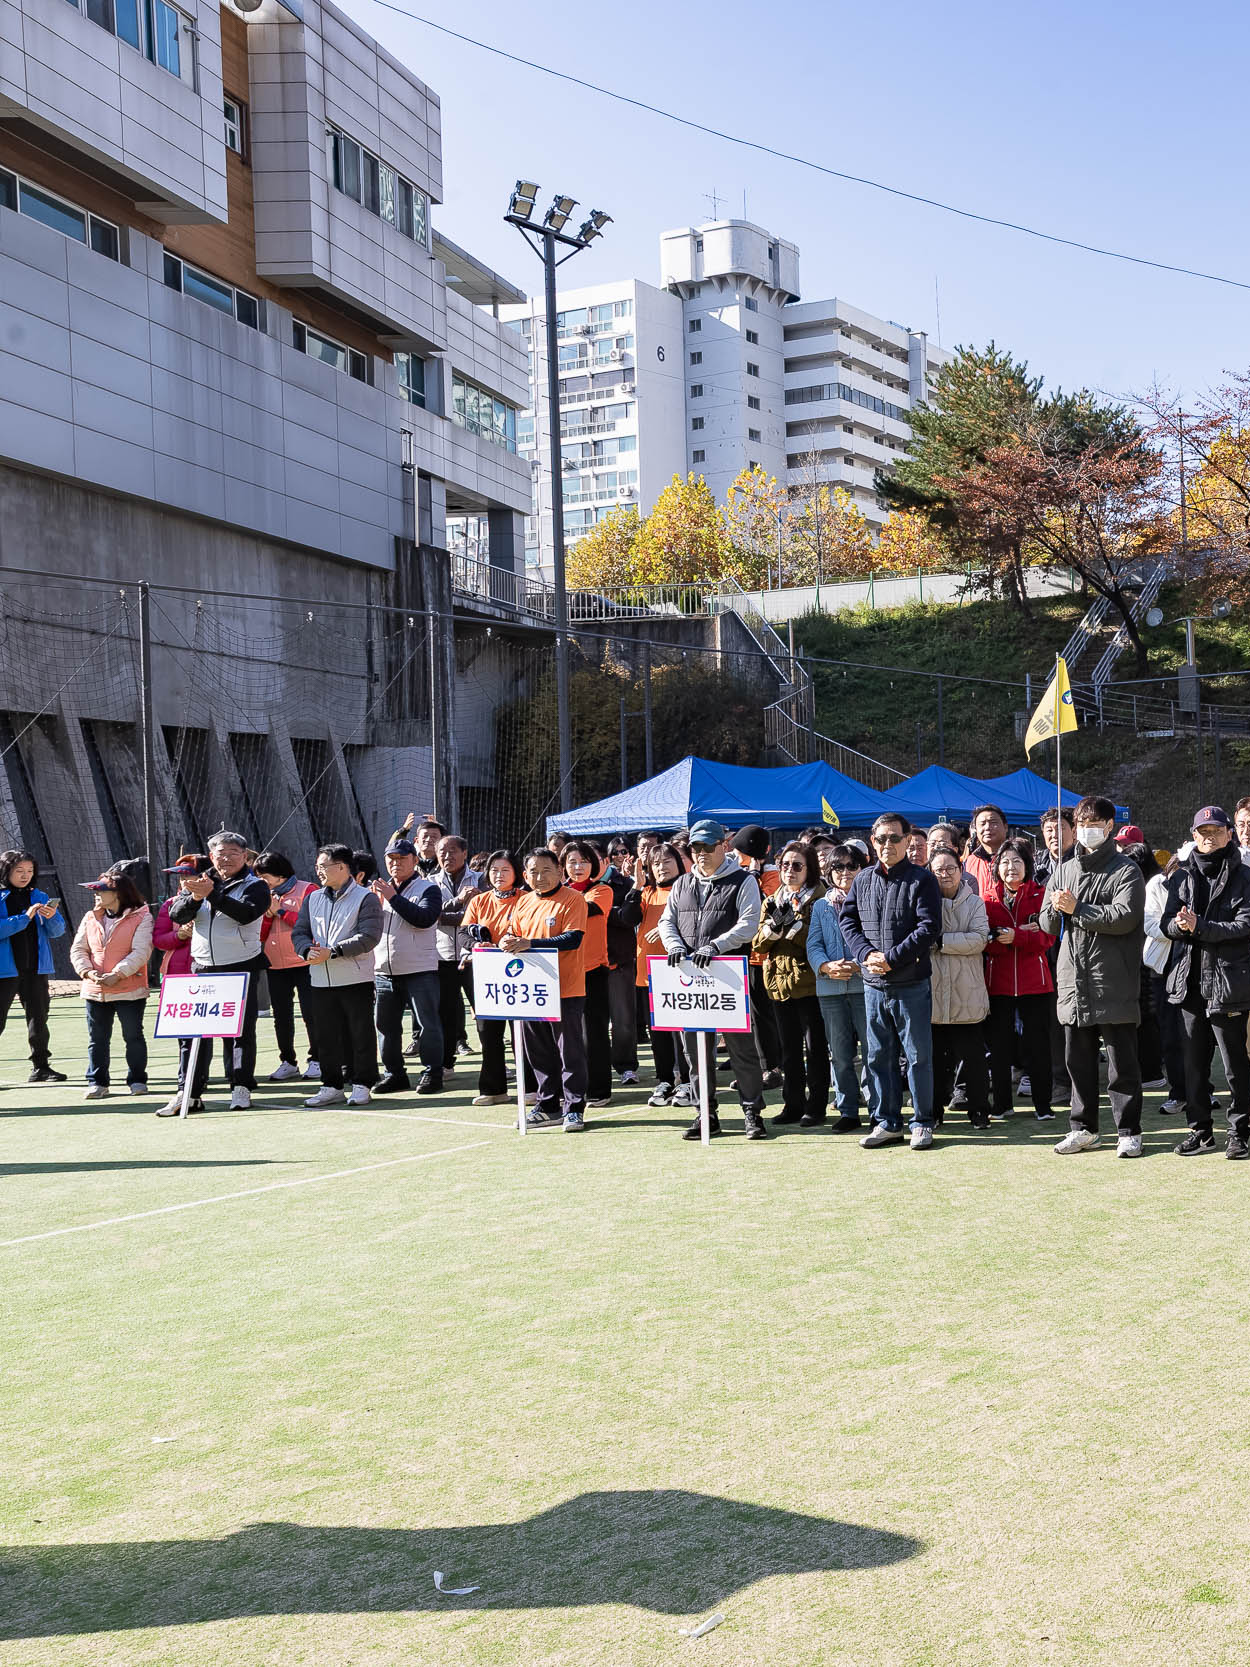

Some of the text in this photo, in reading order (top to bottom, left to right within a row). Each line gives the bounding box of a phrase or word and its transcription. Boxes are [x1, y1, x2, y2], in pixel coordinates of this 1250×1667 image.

[657, 345, 665, 362] 6
[485, 983, 549, 1006] 자양3동
[661, 992, 737, 1011] 자양제2동
[163, 1001, 236, 1019] 자양제4동
